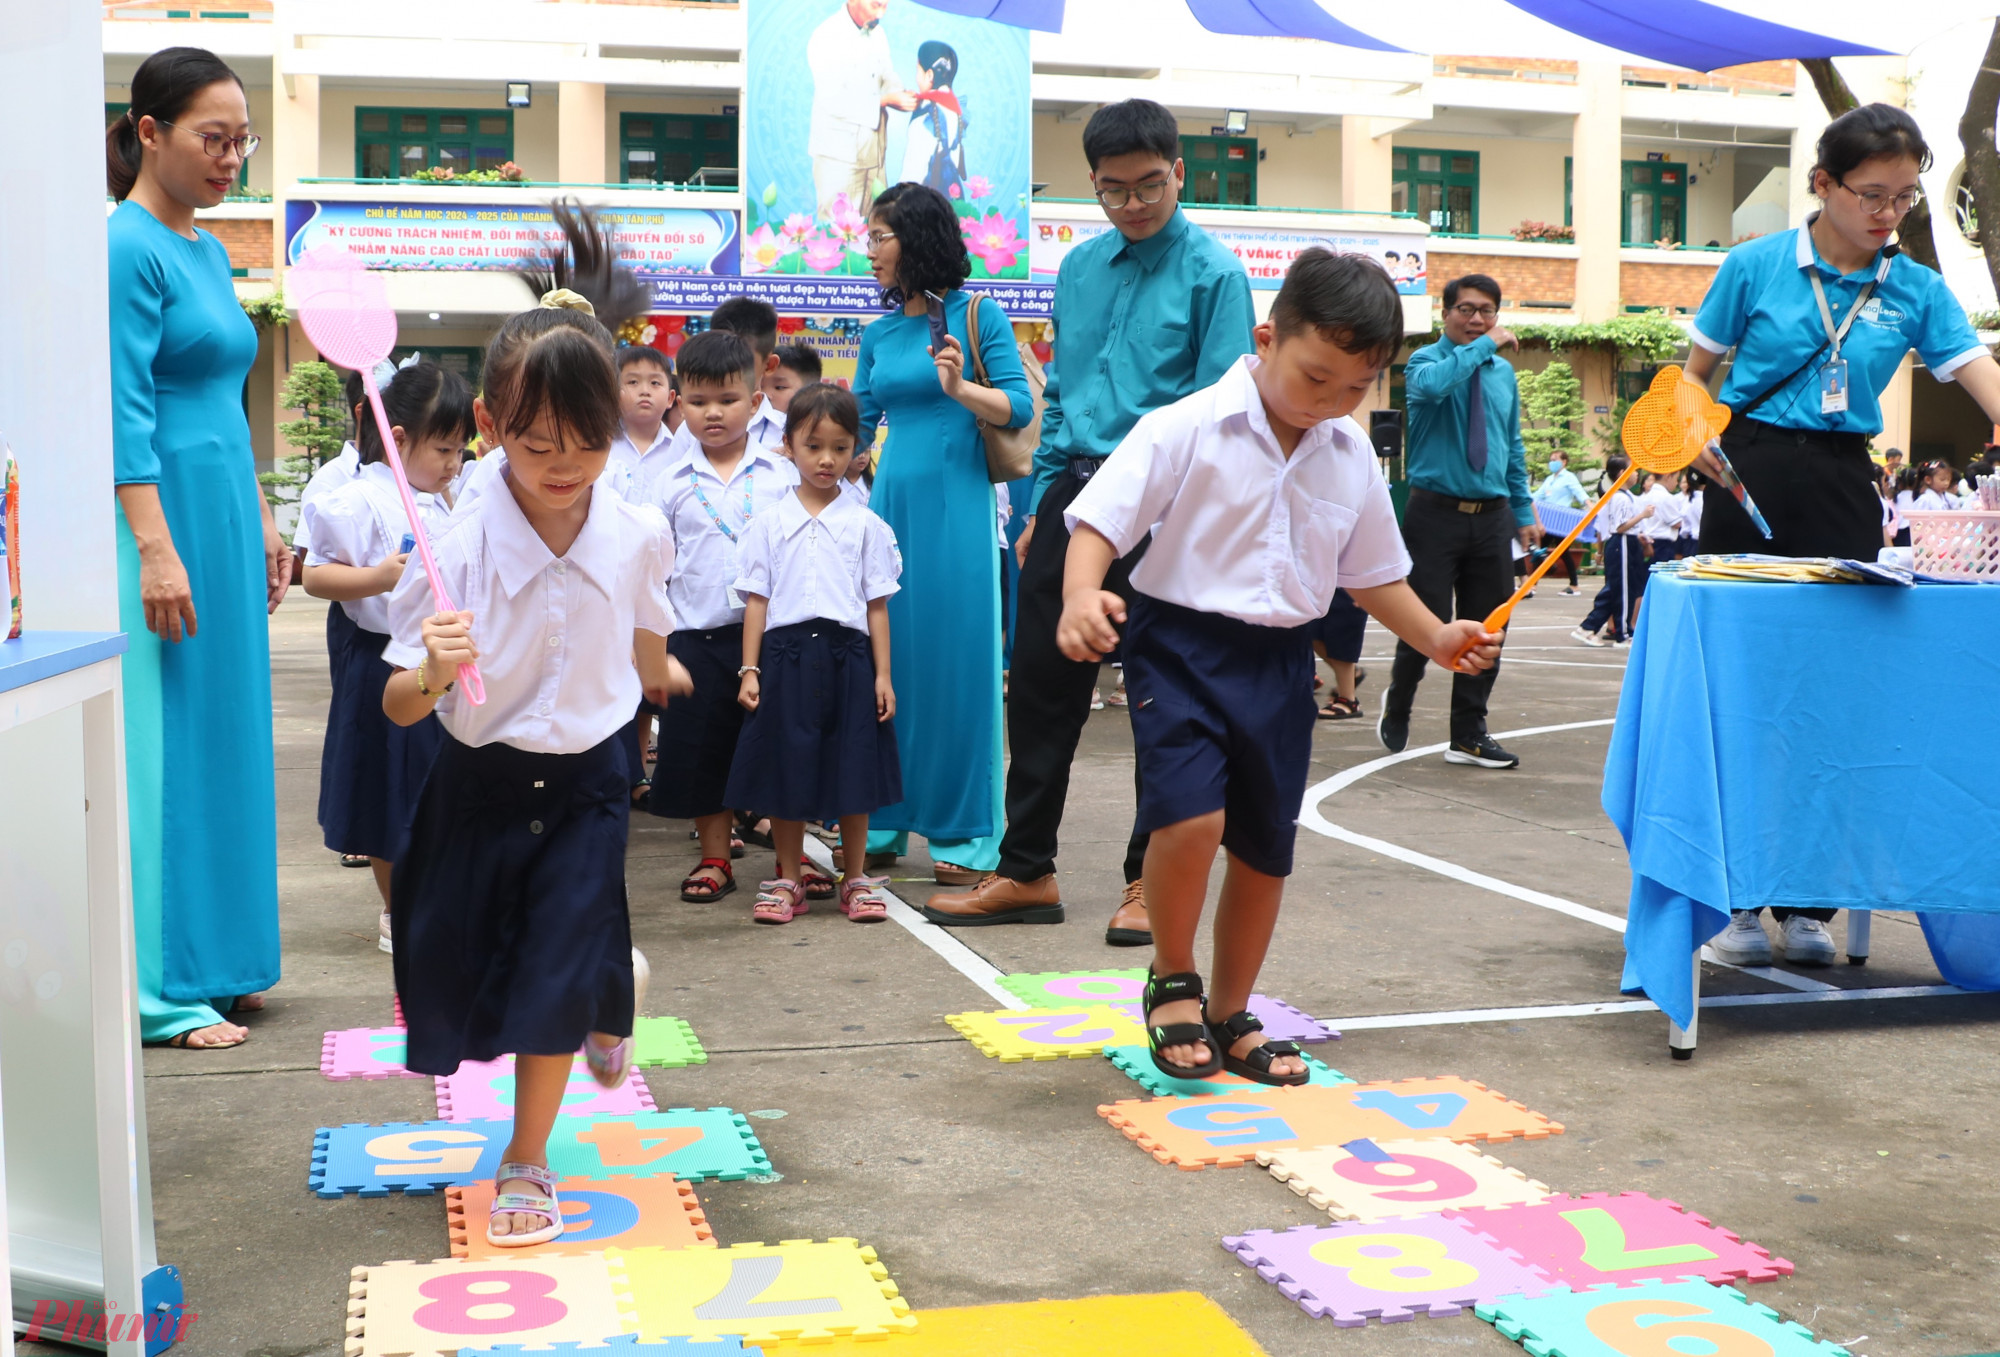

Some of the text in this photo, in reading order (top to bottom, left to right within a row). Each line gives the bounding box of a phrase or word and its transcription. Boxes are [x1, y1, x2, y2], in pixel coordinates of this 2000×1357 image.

[365, 206, 384, 218] CHỦ
[386, 206, 398, 219] ĐỀ
[400, 208, 422, 220] NĂM
[424, 210, 442, 222] HỌC
[446, 210, 468, 220] 2024
[476, 212, 498, 221] 2025
[501, 208, 519, 221] CỦA
[522, 210, 552, 222] NGÀNH
[626, 213, 644, 224] TÂN
[349, 226, 392, 238] CƯƠNG
[396, 228, 438, 239] TRÁCH
[442, 228, 486, 241] NHIỆM,
[490, 226, 511, 240] ĐỔI
[515, 229, 540, 241] MỚI
[664, 230, 685, 244] ĐỔI
[688, 230, 705, 244] SỐ
[348, 240, 386, 254] NHẰM
[390, 243, 426, 256] NÂNG
[430, 246, 454, 256] CAO
[458, 244, 490, 257] CHẤT
[494, 246, 536, 260] LƯỢNG
[1250, 263, 1280, 278] TIẾP
[657, 280, 679, 292] Việt
[682, 282, 708, 291] Nam
[711, 281, 726, 292] có
[728, 282, 744, 292] trở
[746, 282, 767, 292] nên
[770, 284, 790, 293] tươi
[794, 284, 814, 296] đẹp
[818, 285, 838, 297] hay
[842, 285, 879, 297] không,
[994, 288, 1020, 298] bước
[1023, 288, 1037, 298] tới
[686, 292, 714, 304] quốc
[776, 295, 805, 307] được
[808, 296, 828, 307] hay
[830, 296, 868, 308] không,
[1012, 298, 1019, 310] ở
[1021, 300, 1048, 312] công
[818, 335, 845, 346] NHÂN
[837, 346, 858, 358] TIỂU
[1350, 1090, 1469, 1129] 4
[1166, 1102, 1300, 1147] 5
[365, 1130, 488, 1176] 5
[576, 1122, 705, 1167] 4
[1558, 1208, 1720, 1272] 7
[1309, 1233, 1480, 1292] 8
[412, 1270, 568, 1334] 8
[692, 1255, 842, 1320] 7
